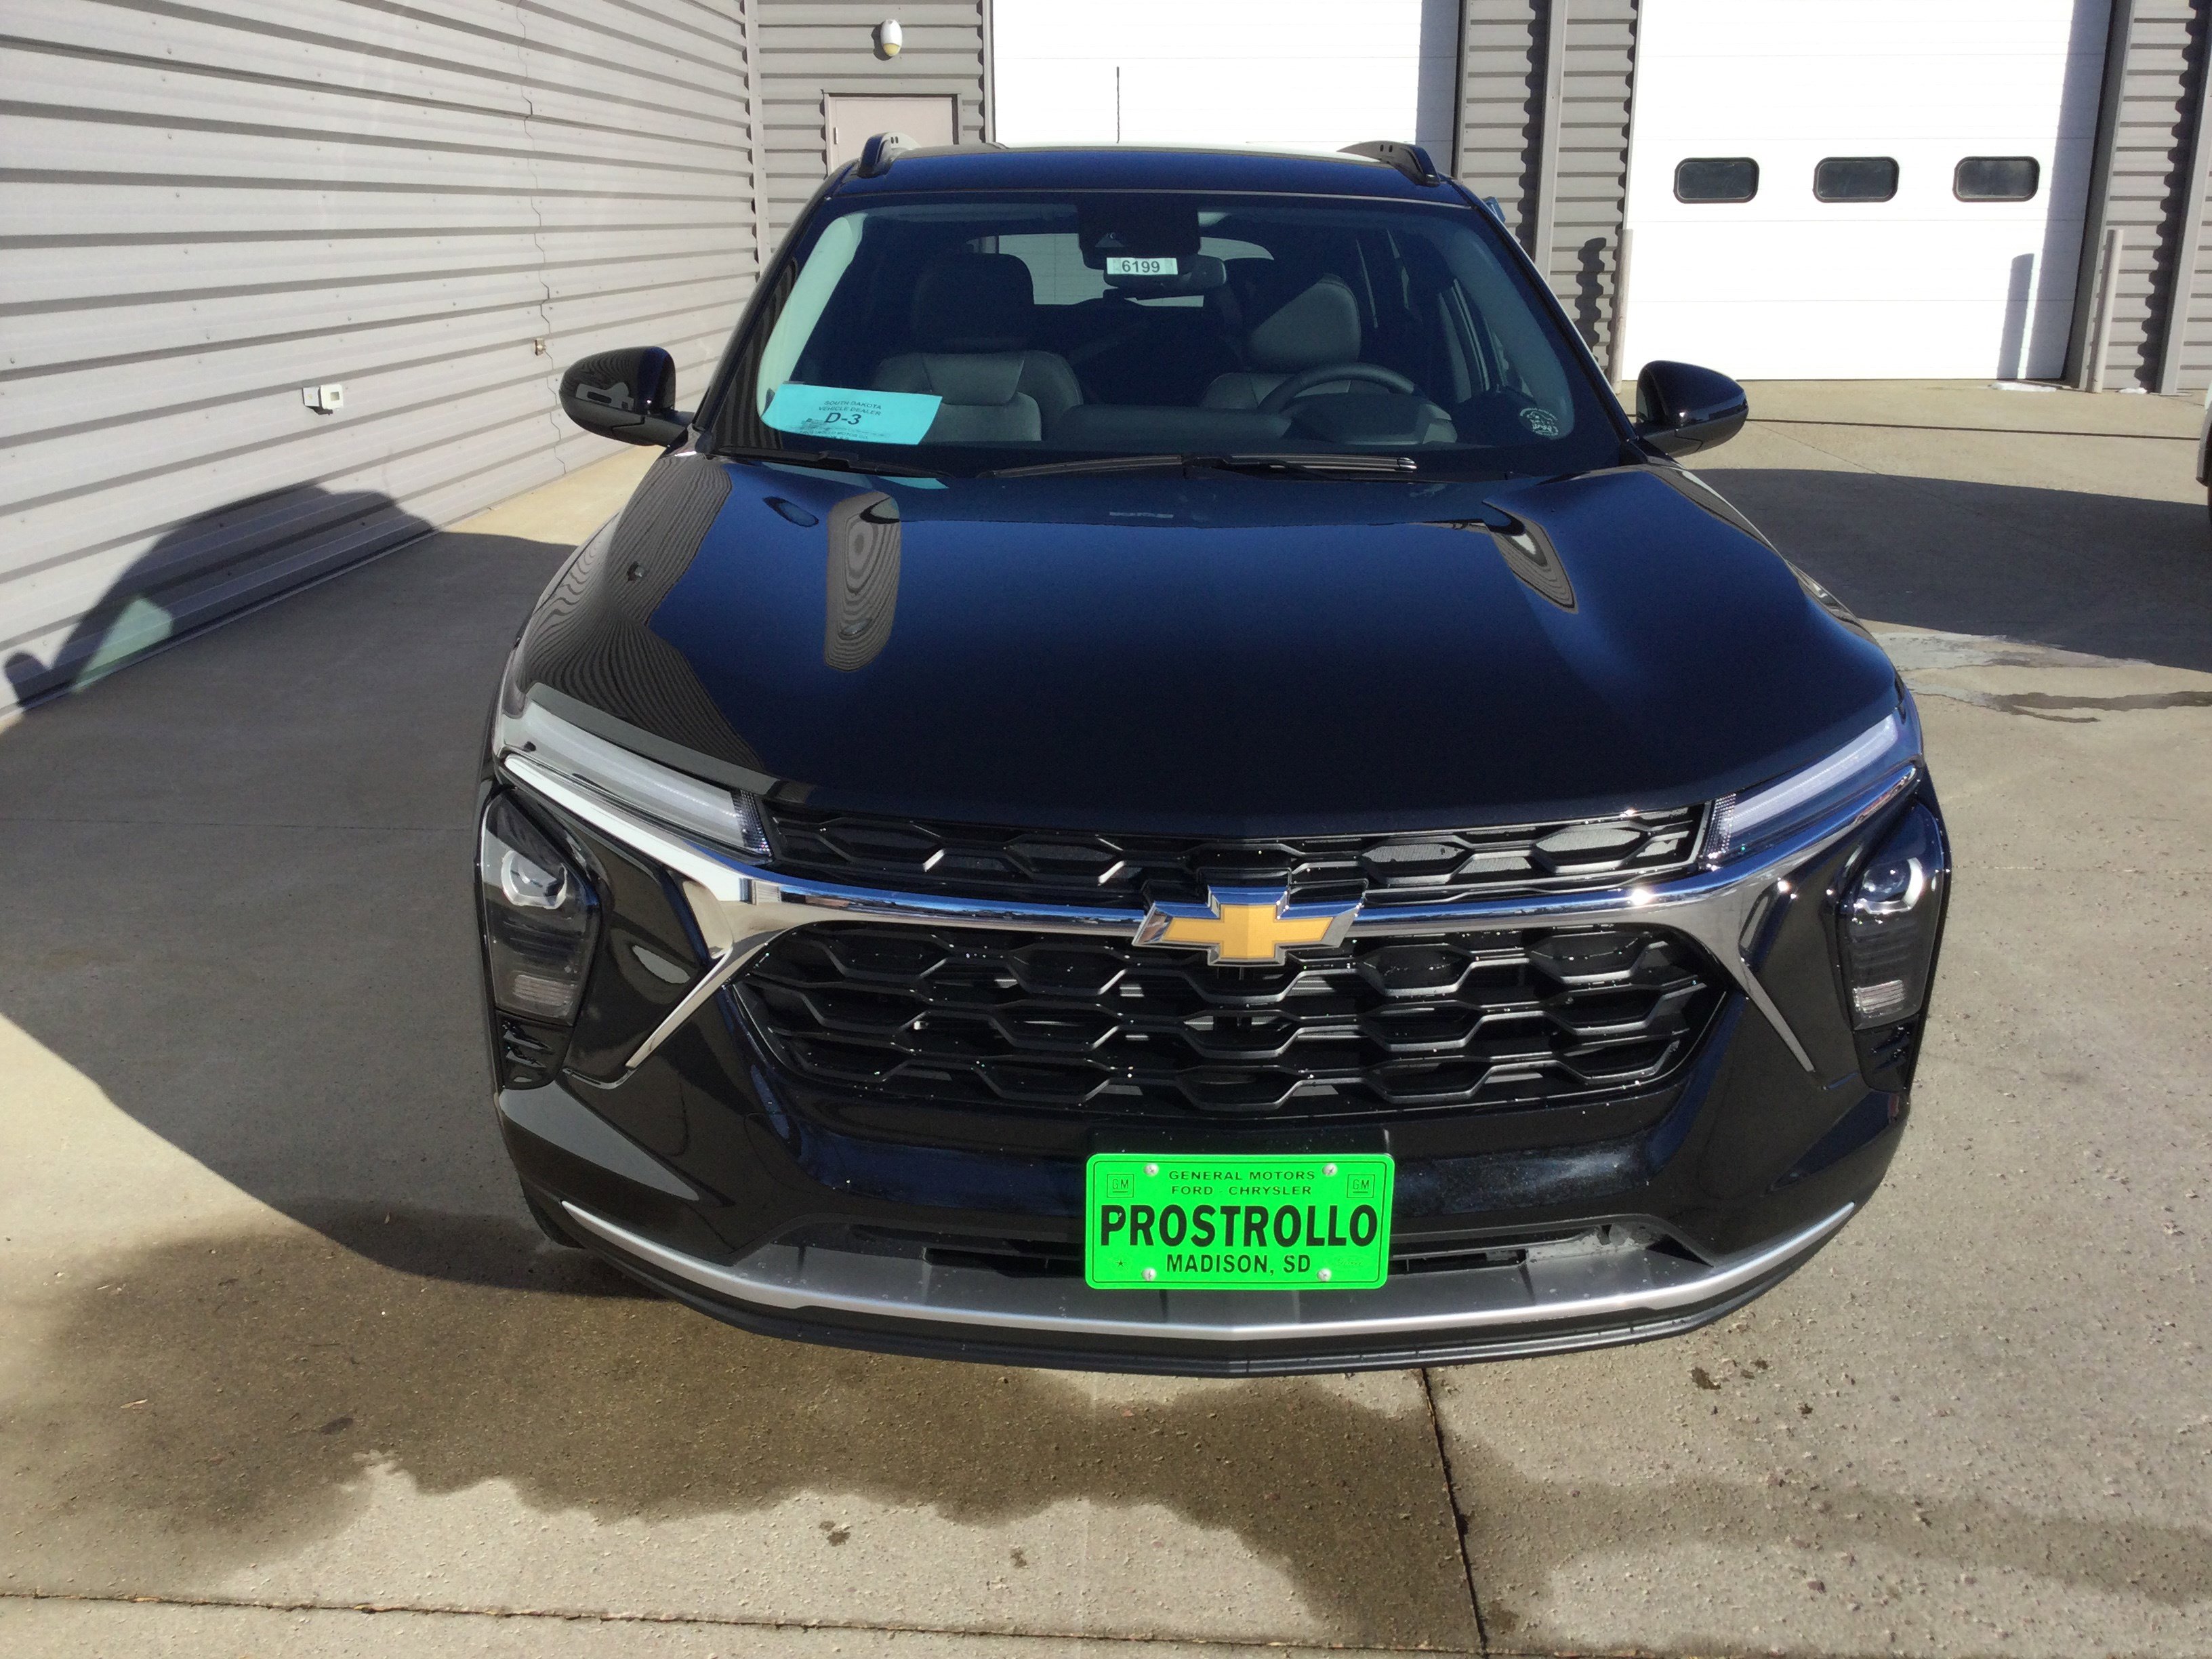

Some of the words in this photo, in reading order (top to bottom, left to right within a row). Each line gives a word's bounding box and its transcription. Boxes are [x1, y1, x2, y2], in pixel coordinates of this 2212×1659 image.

[1122, 260, 1160, 273] 6199
[850, 401, 882, 410] DAKOTA
[850, 407, 882, 416] DEALER
[824, 412, 862, 425] D-3
[1169, 1170, 1242, 1181] GENERAL
[1249, 1170, 1315, 1181] MOTORS
[1112, 1179, 1129, 1189] GM
[1353, 1179, 1370, 1190] GM
[1171, 1185, 1213, 1195] FORD
[1229, 1186, 1311, 1195] CHRYSLER
[1100, 1204, 1378, 1248] PROSTROLLO
[1166, 1254, 1274, 1276] MADISON,
[1283, 1254, 1311, 1273] SD
